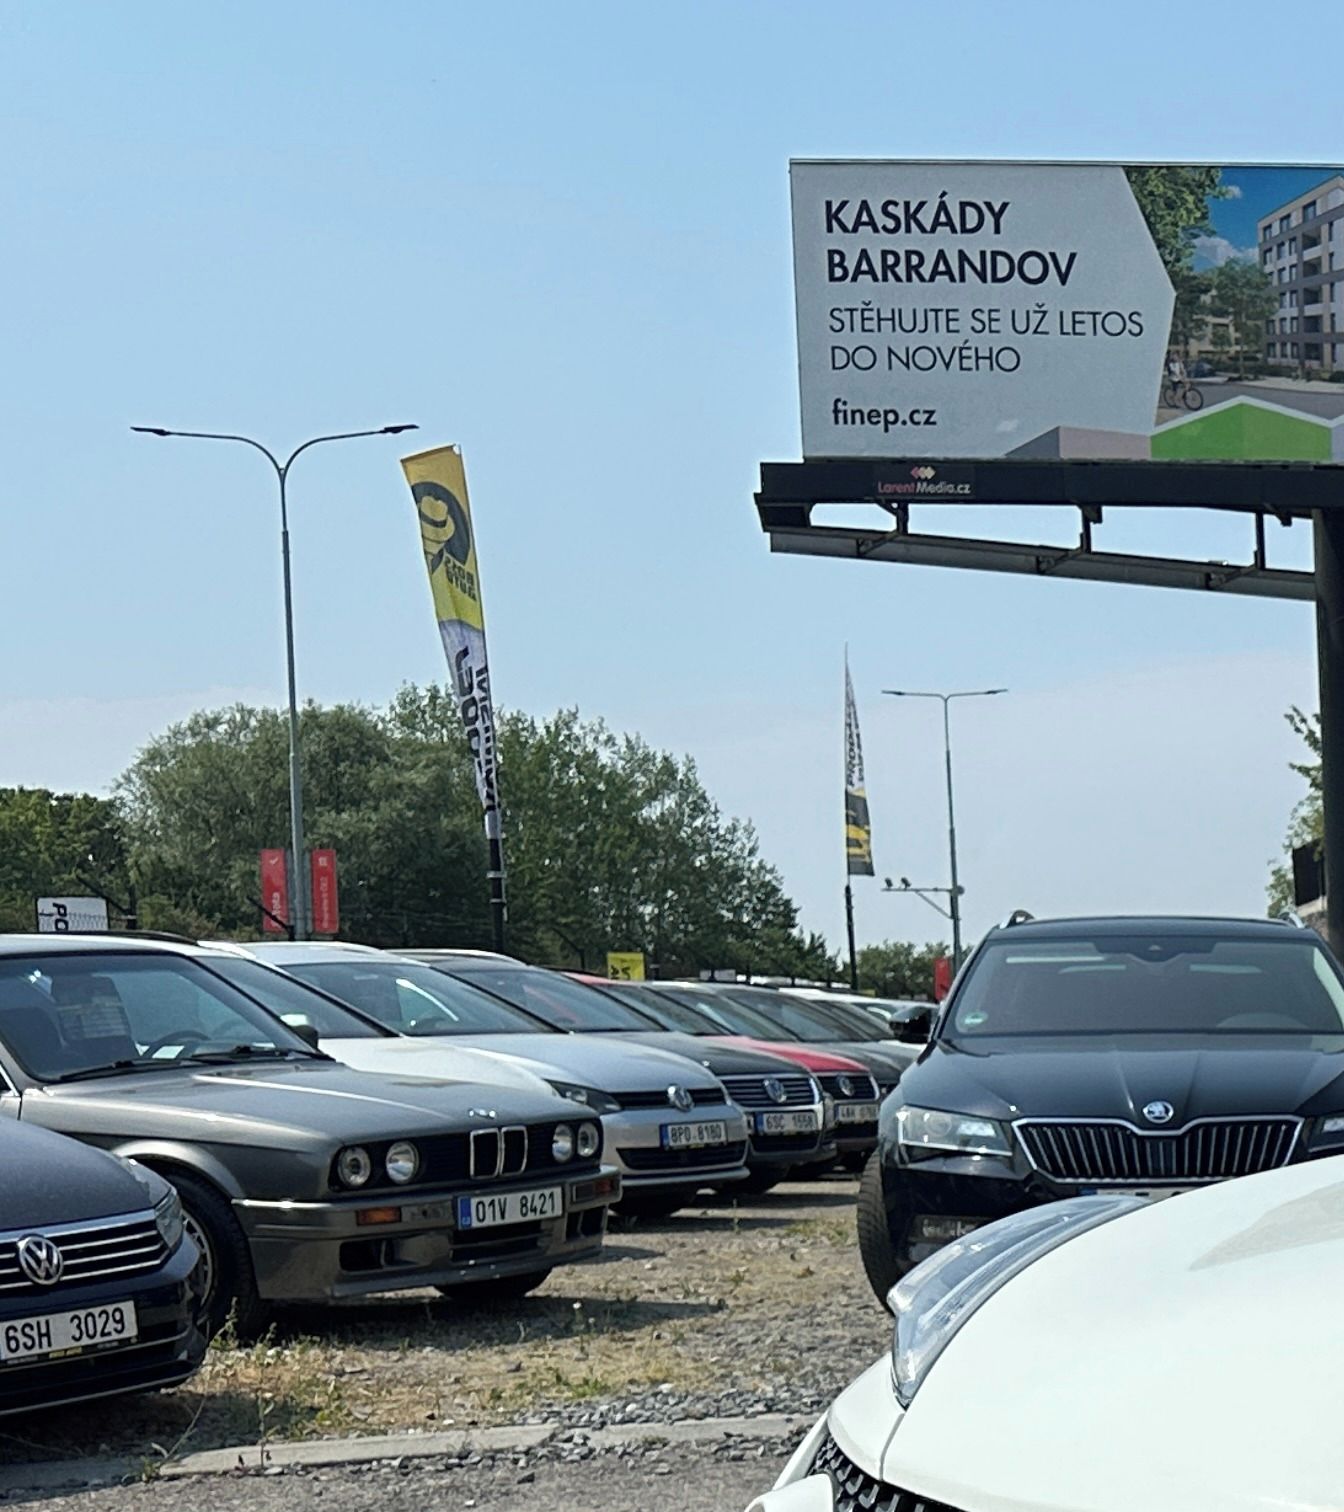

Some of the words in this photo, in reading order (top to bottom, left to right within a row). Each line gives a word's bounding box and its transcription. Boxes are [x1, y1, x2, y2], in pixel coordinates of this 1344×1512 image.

[825, 190, 1011, 235] KASKÁDY
[827, 249, 1078, 286] BARRANDOV
[829, 300, 960, 334] STĚHUJTE
[970, 308, 1001, 334] SE
[1011, 303, 1050, 336] UŽ
[1059, 310, 1144, 338] LETOS
[831, 345, 877, 371] DO
[888, 339, 1021, 373] NOVÉHO
[832, 398, 937, 433] finep.cz
[475, 1197, 508, 1224] 01V
[519, 1191, 556, 1218] 8421
[4, 1319, 53, 1354] 6SH
[69, 1306, 126, 1343] 3029
